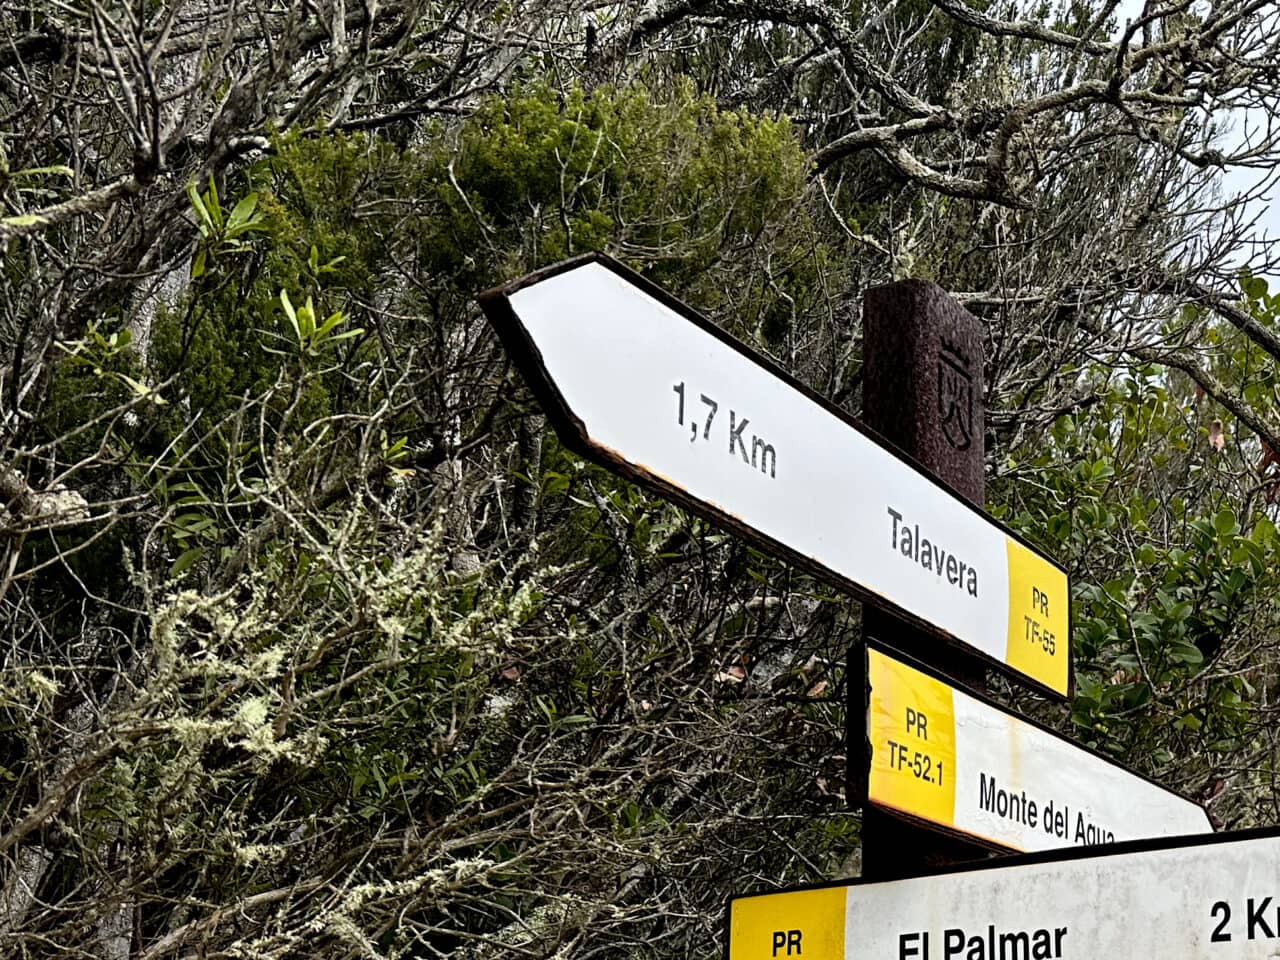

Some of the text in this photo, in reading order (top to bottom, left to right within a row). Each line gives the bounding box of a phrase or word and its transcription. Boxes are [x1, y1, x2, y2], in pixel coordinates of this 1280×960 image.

[673, 381, 979, 598] 1,7 Km Talavera
[1032, 586, 1050, 618] PR
[1024, 616, 1056, 657] TF-55
[906, 707, 928, 740] PR
[888, 741, 943, 786] TF-52.1
[979, 772, 1038, 828] Monte
[1043, 800, 1069, 840] del
[1210, 901, 1232, 943] 2
[772, 929, 802, 957] PR
